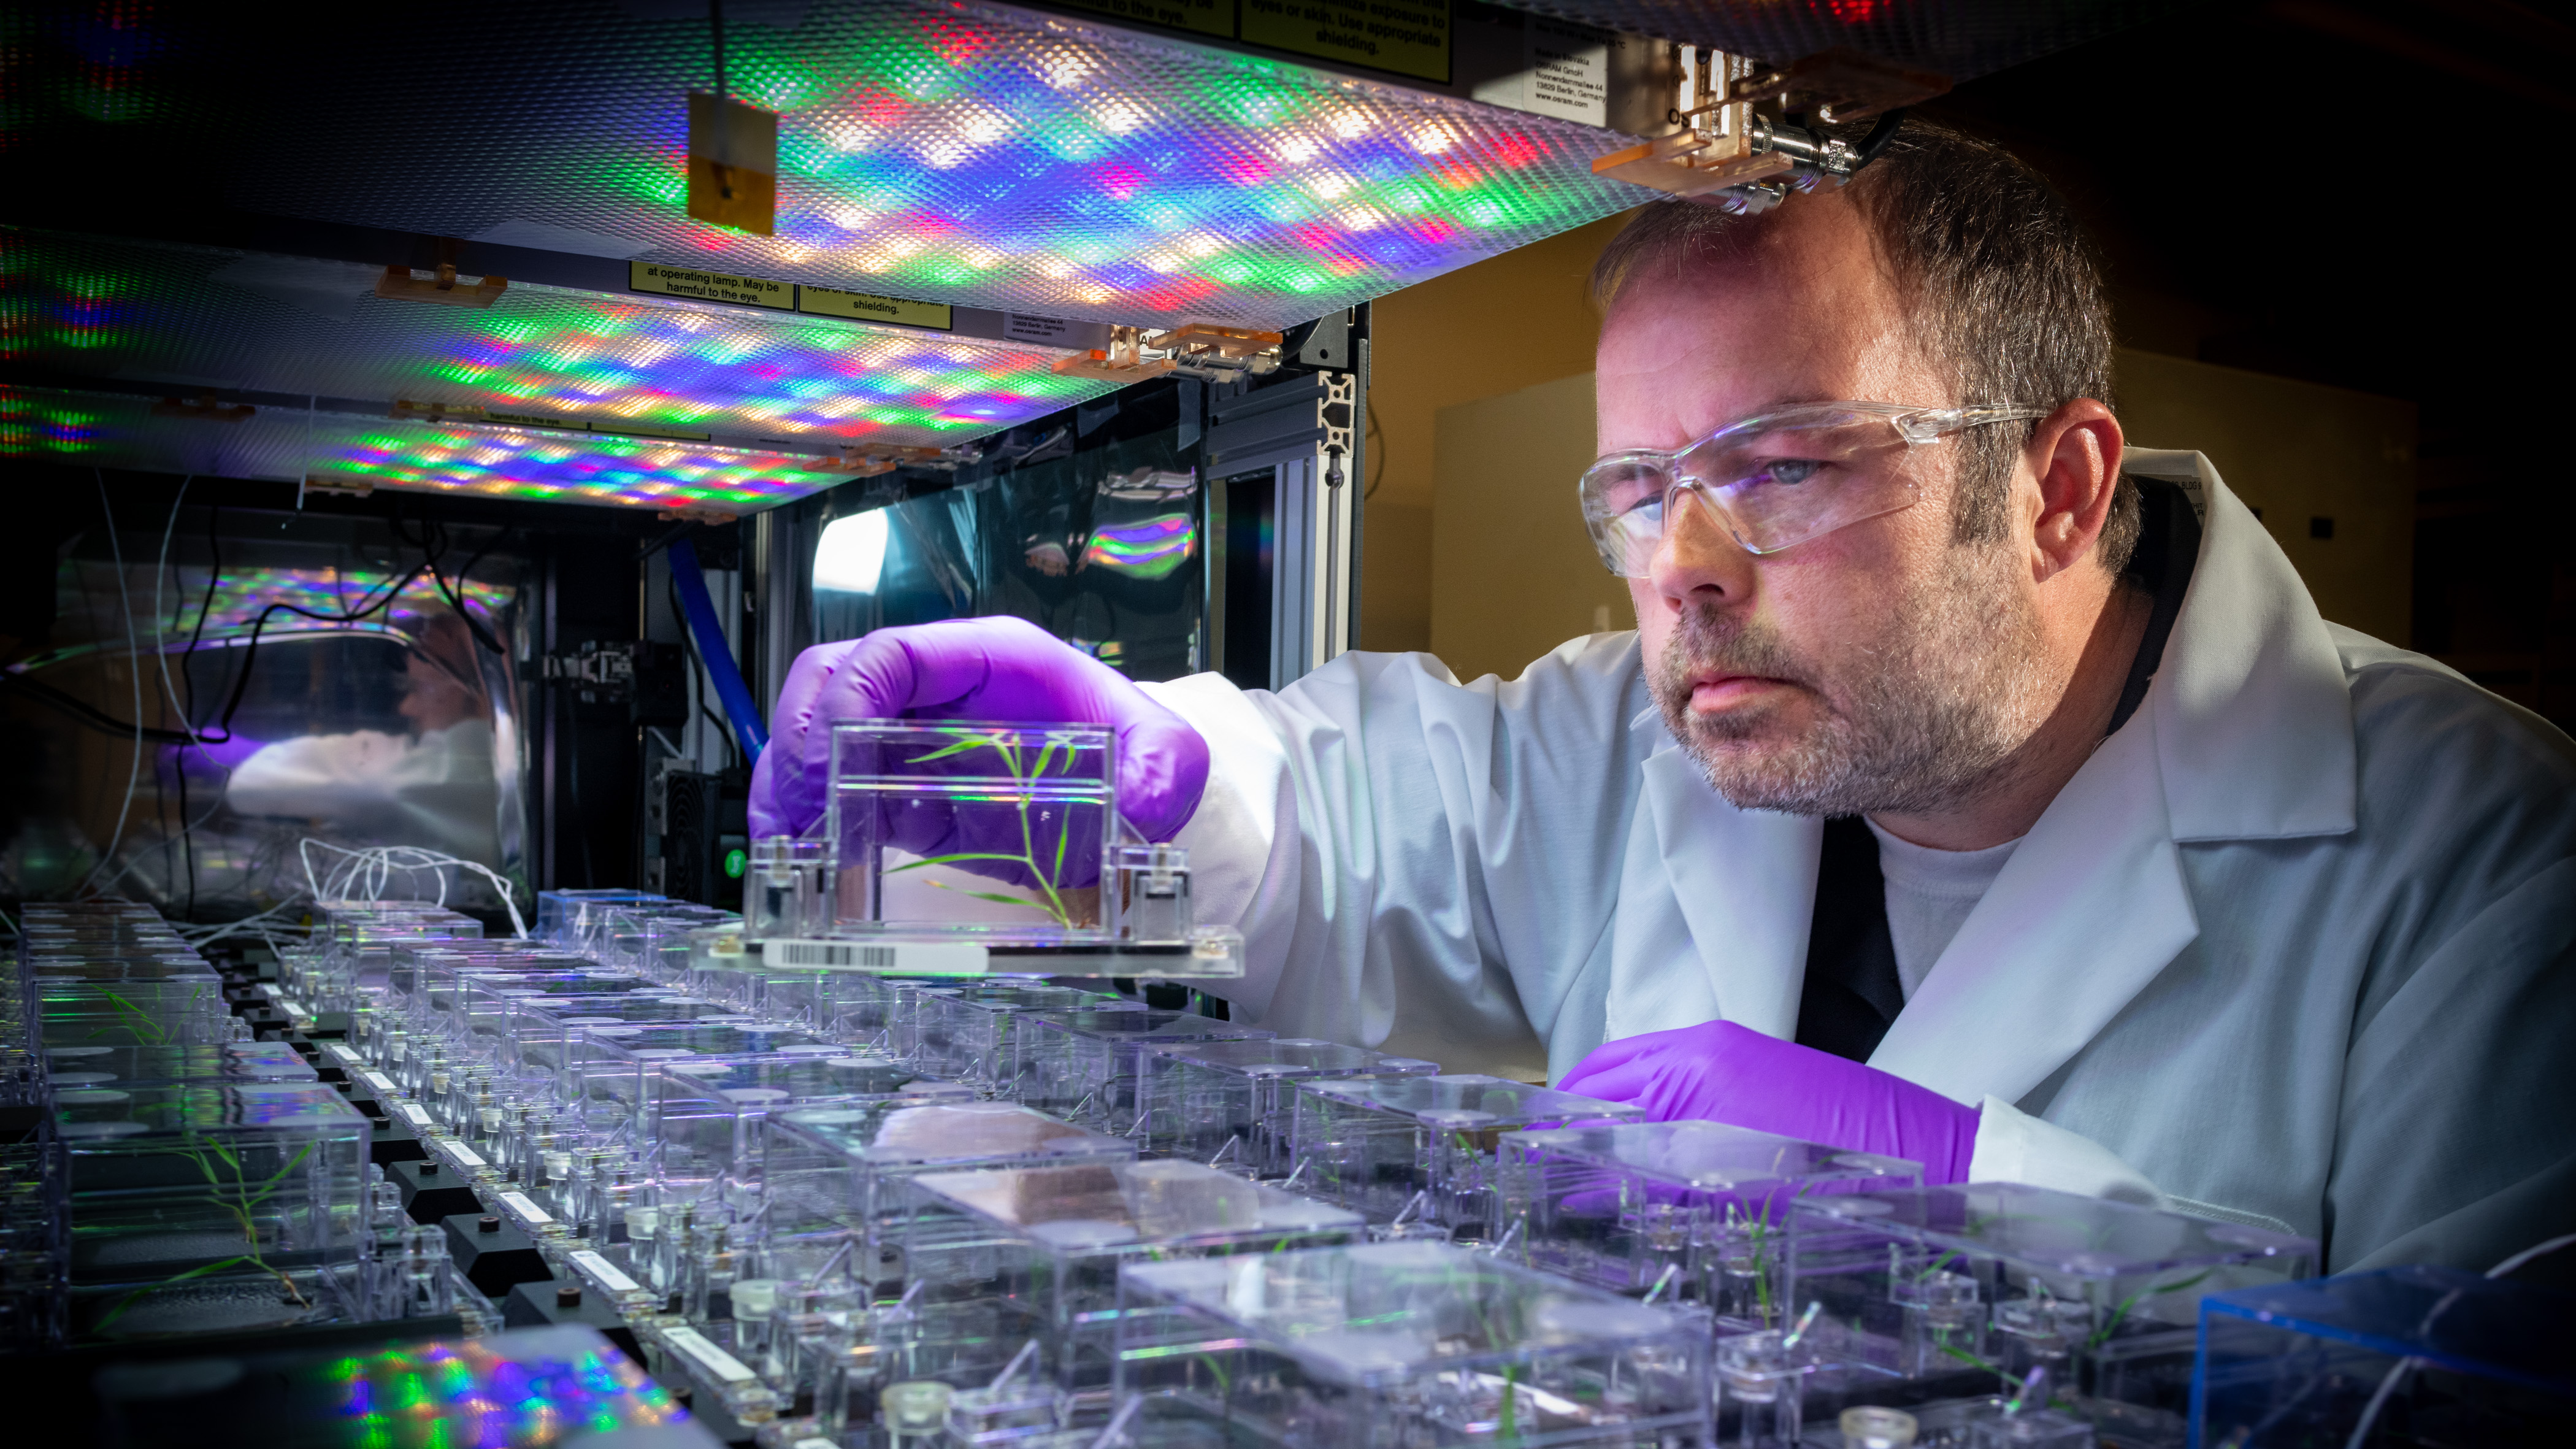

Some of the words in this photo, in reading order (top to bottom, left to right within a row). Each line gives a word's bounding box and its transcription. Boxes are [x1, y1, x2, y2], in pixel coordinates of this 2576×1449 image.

[1113, 0, 1127, 12] to
[1131, 1, 1154, 18] the
[1159, 9, 1187, 25] eye.
[1370, 4, 1429, 26] exposure
[1432, 15, 1445, 29] to
[1252, 0, 1282, 13] eyes
[1287, 5, 1300, 17] or
[1304, 7, 1335, 25] skin.
[1339, 12, 1363, 31] Use
[1367, 22, 1441, 47] appropriate
[1316, 30, 1379, 56] shielding.
[1536, 61, 1562, 72] OSRAM
[1563, 66, 1584, 78] GmbH
[1562, 53, 1590, 66] Slovakia
[1536, 71, 1594, 90] Nonnendammallee
[1595, 83, 1603, 92] 44
[1536, 80, 1555, 91] 13829
[1577, 89, 1606, 104] Germany
[1536, 91, 1589, 109] www.osram.com
[647, 267, 658, 276] at
[660, 269, 710, 285] operating
[713, 274, 741, 288] lamp.
[743, 279, 764, 292] May
[767, 282, 780, 292] be
[667, 282, 706, 296] harmful
[708, 286, 719, 298] to
[721, 289, 738, 300] the
[740, 292, 761, 303] eye.
[853, 299, 900, 315] shielding.
[489, 412, 521, 421] harmful
[2182, 481, 2197, 490] BLDG
[2198, 481, 2202, 490] 9
